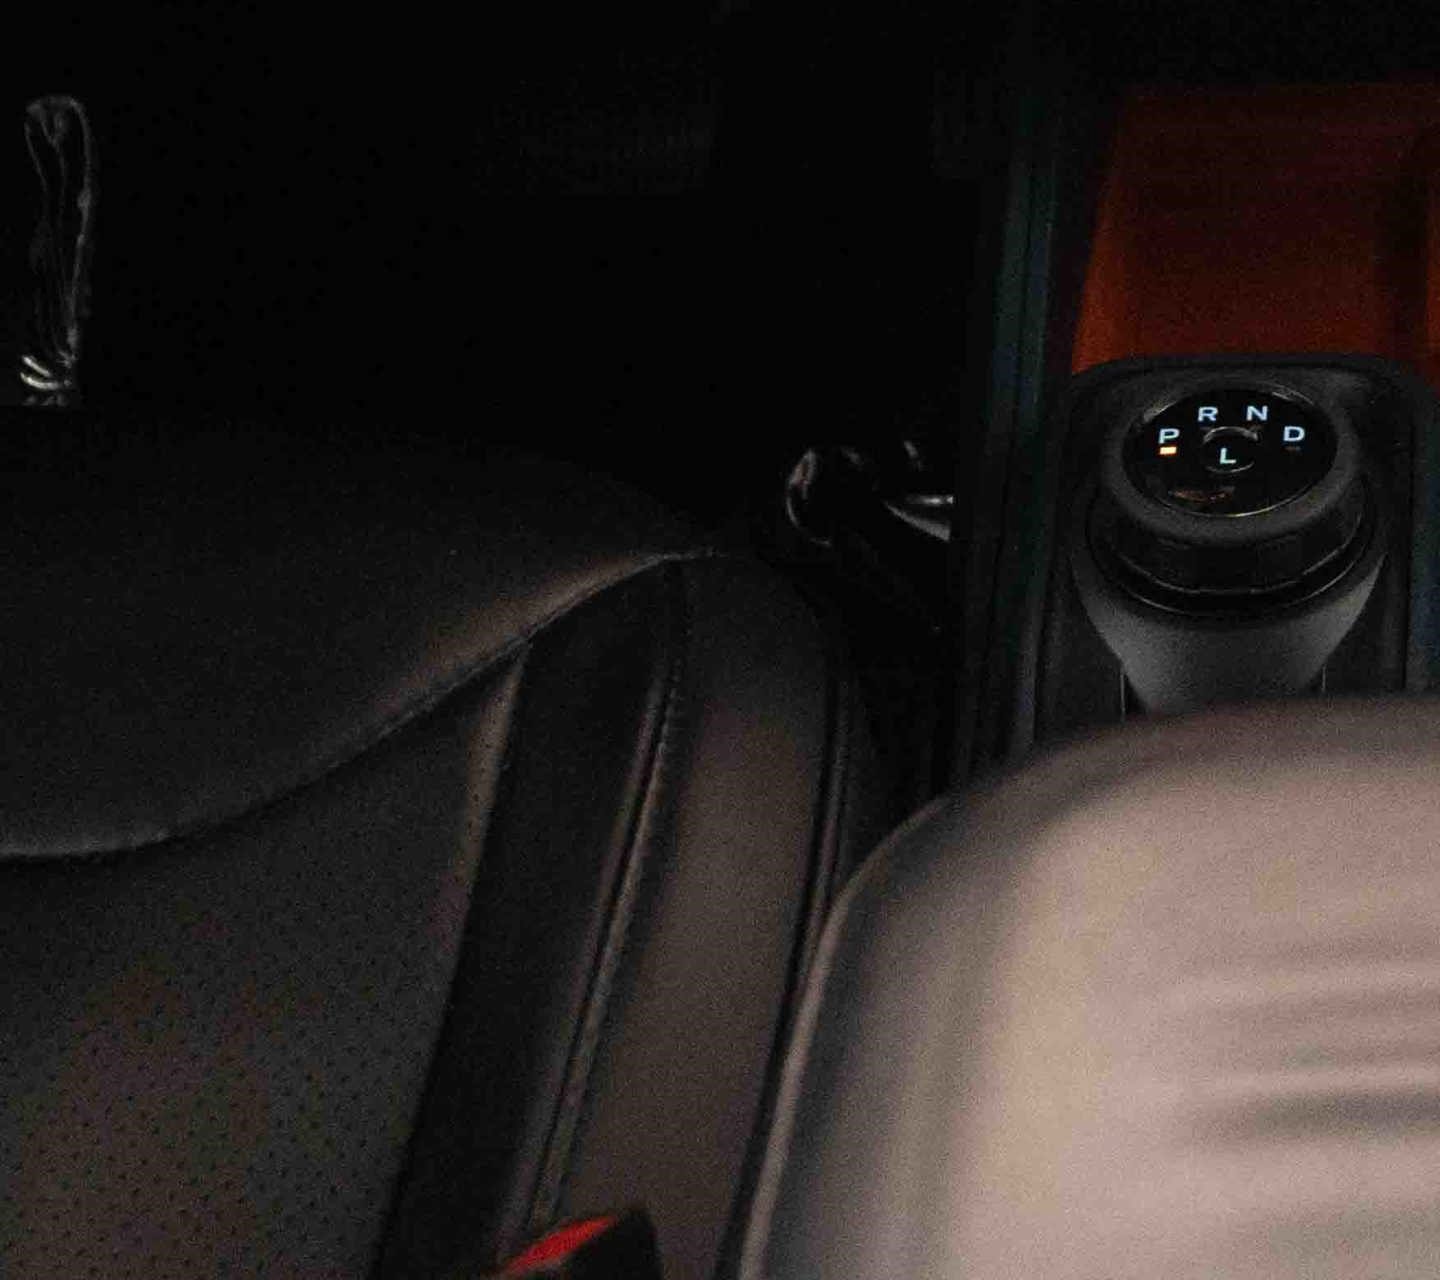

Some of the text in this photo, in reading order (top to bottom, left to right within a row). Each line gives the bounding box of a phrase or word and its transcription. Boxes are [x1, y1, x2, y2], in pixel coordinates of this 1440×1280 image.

[1197, 406, 1218, 422] R
[1246, 405, 1269, 422] N
[1158, 428, 1180, 444] P
[1283, 426, 1306, 442] D
[1219, 447, 1238, 464] L
